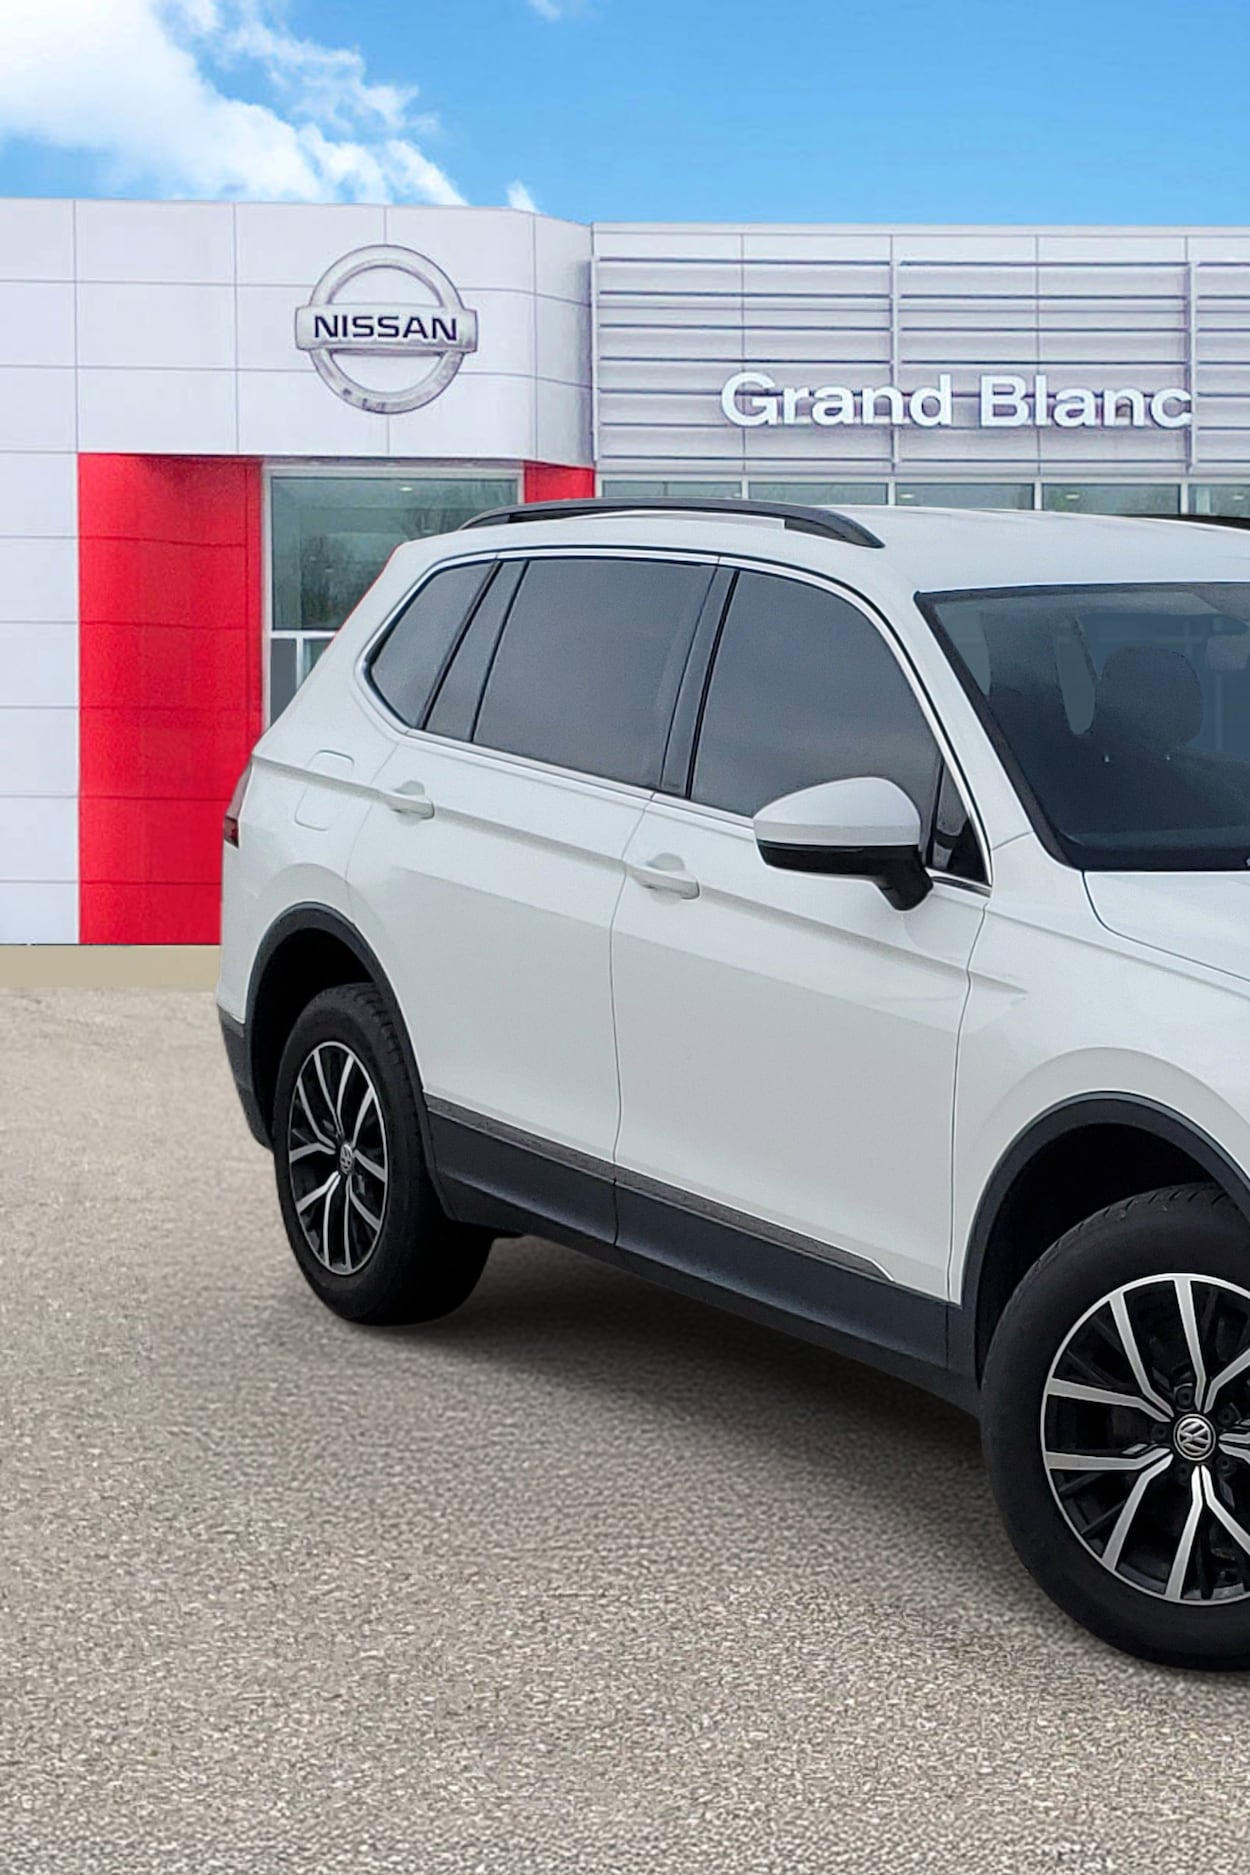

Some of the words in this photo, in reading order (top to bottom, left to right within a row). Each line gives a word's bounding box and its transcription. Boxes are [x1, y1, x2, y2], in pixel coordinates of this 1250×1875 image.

[314, 315, 457, 341] NISSAN
[721, 372, 952, 427] Grand
[980, 373, 1193, 428] Blanc
